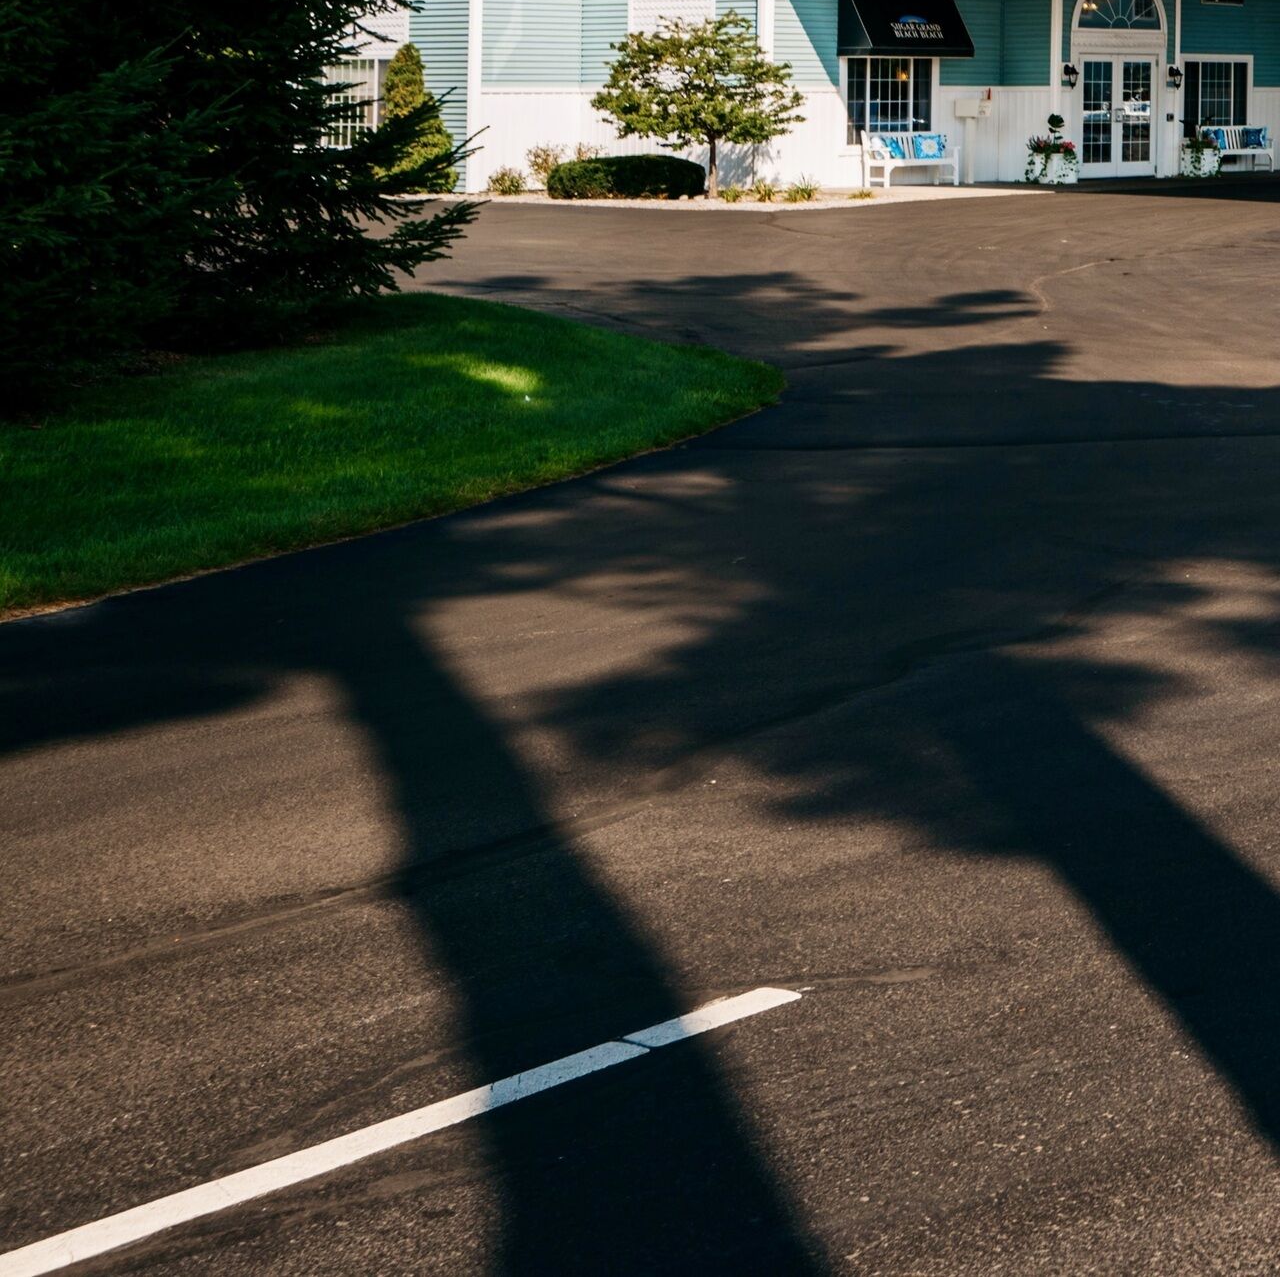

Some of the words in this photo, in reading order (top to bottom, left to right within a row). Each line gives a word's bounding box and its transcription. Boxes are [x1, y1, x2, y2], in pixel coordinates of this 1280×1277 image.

[890, 22, 915, 31] SUGAR
[916, 23, 941, 31] GRAND
[894, 30, 919, 38] BEACH
[920, 31, 944, 39] BEACH
